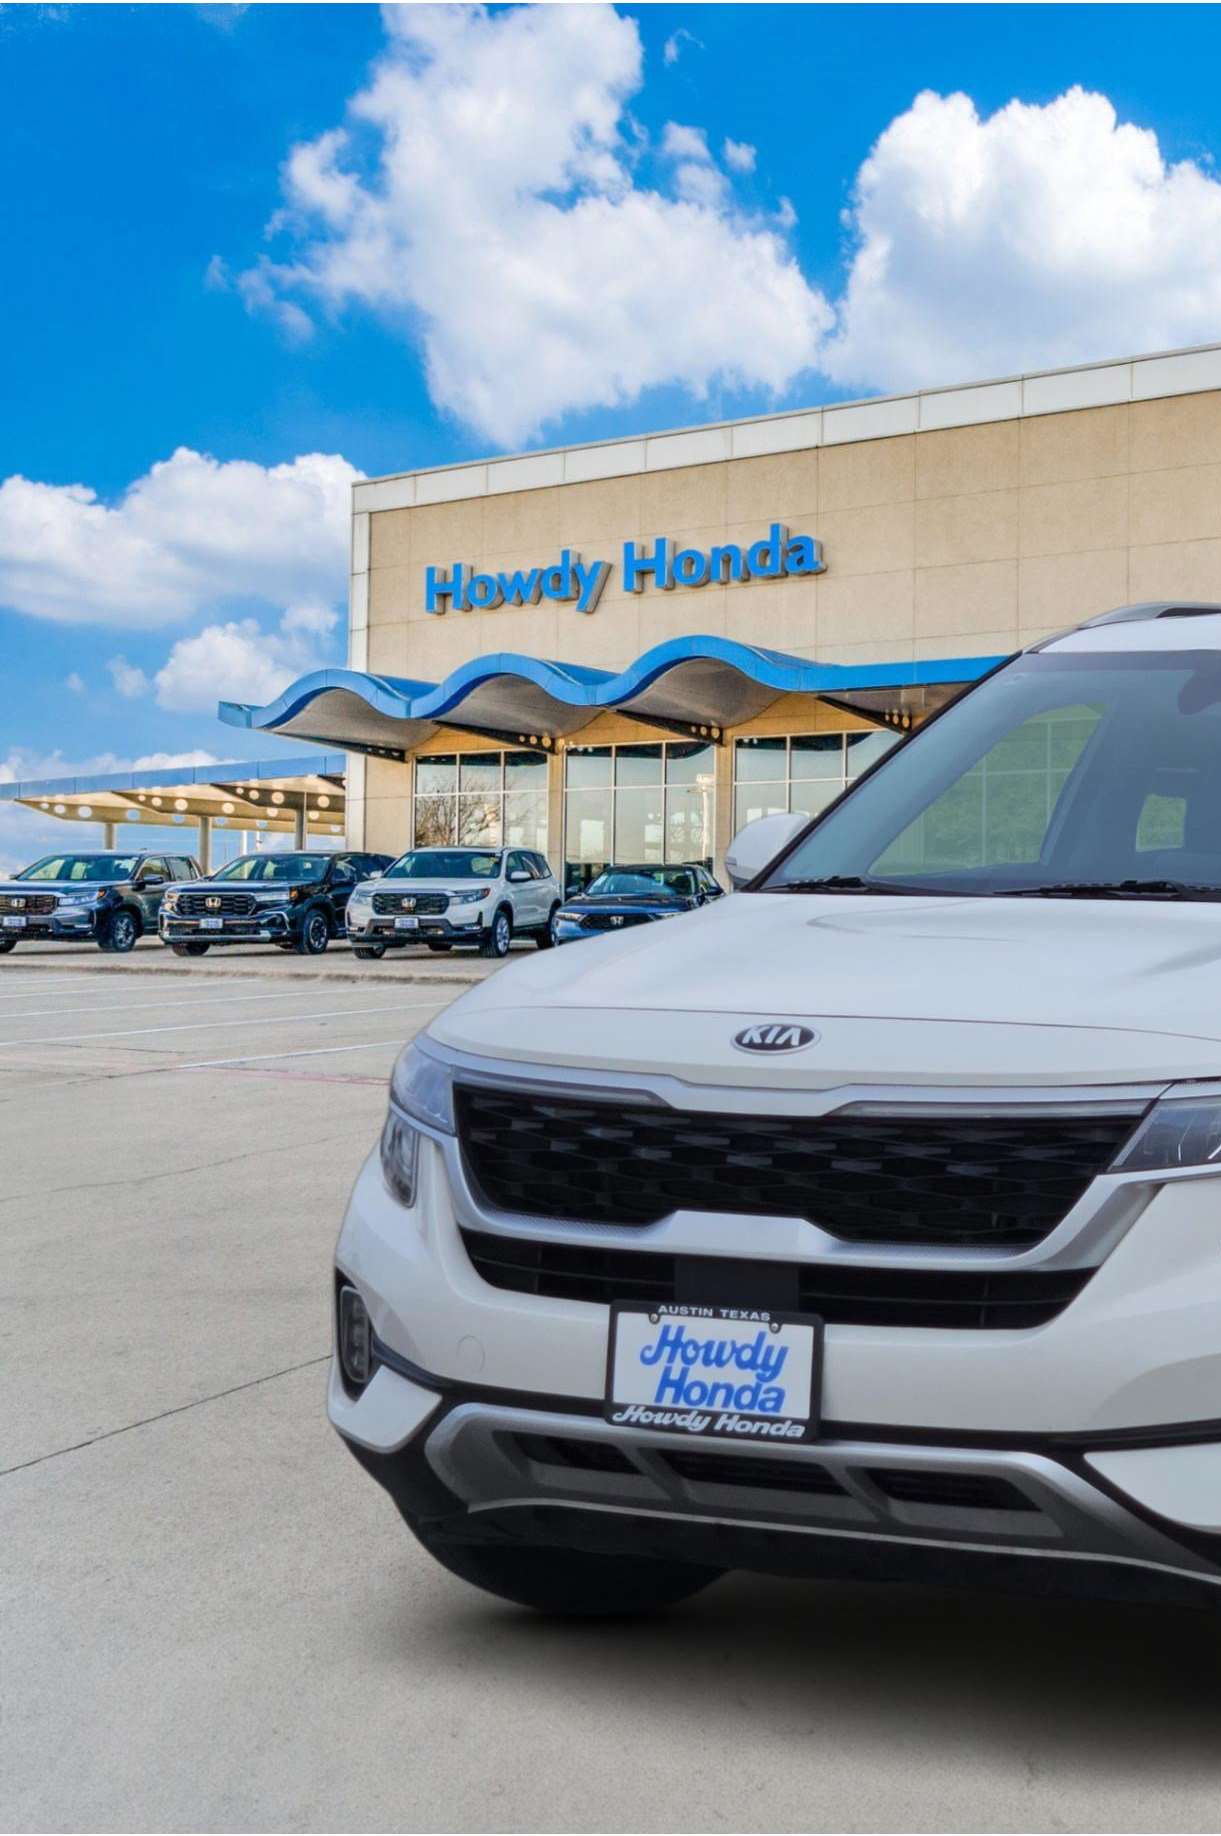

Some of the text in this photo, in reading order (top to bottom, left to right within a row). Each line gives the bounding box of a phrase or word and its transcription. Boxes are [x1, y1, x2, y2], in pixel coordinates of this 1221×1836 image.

[425, 523, 827, 615] Howdy Honda
[741, 1024, 802, 1046] KIA
[658, 1304, 771, 1322] AUSTIN TEXAS
[640, 1324, 789, 1383] Howdy
[654, 1365, 786, 1414] Honda
[612, 1404, 806, 1438] Howdy Honda
